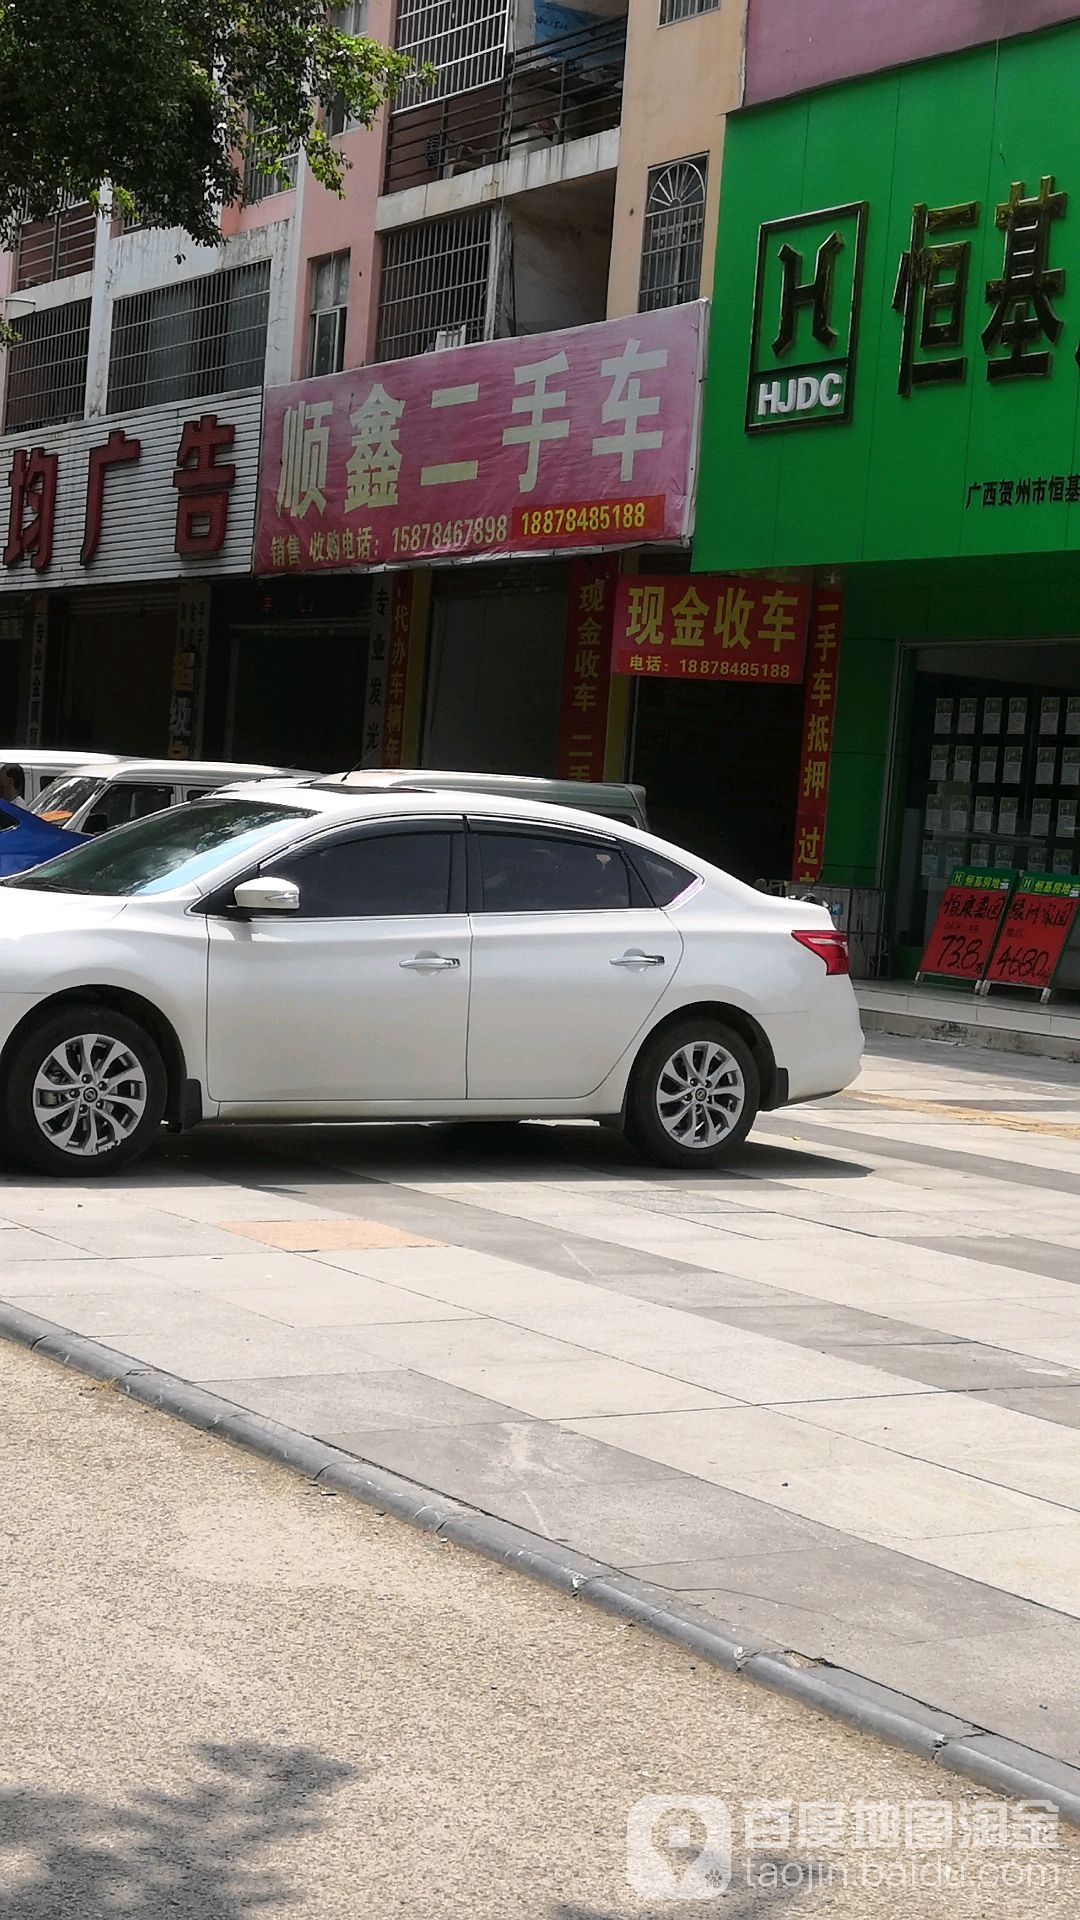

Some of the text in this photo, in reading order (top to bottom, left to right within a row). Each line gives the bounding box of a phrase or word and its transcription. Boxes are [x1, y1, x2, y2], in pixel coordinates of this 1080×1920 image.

[892, 174, 1080, 397] 恒基
[757, 372, 843, 416] HJDC
[275, 338, 668, 519] 顺鑫二手车
[270, 533, 302, 567] 销售
[392, 517, 508, 553] 15878467898
[521, 502, 646, 536] 18878485188
[572, 580, 606, 713] 现金收车
[625, 584, 799, 653] 现金收车
[679, 659, 791, 680] 18878485188
[796, 828, 820, 882] 过
